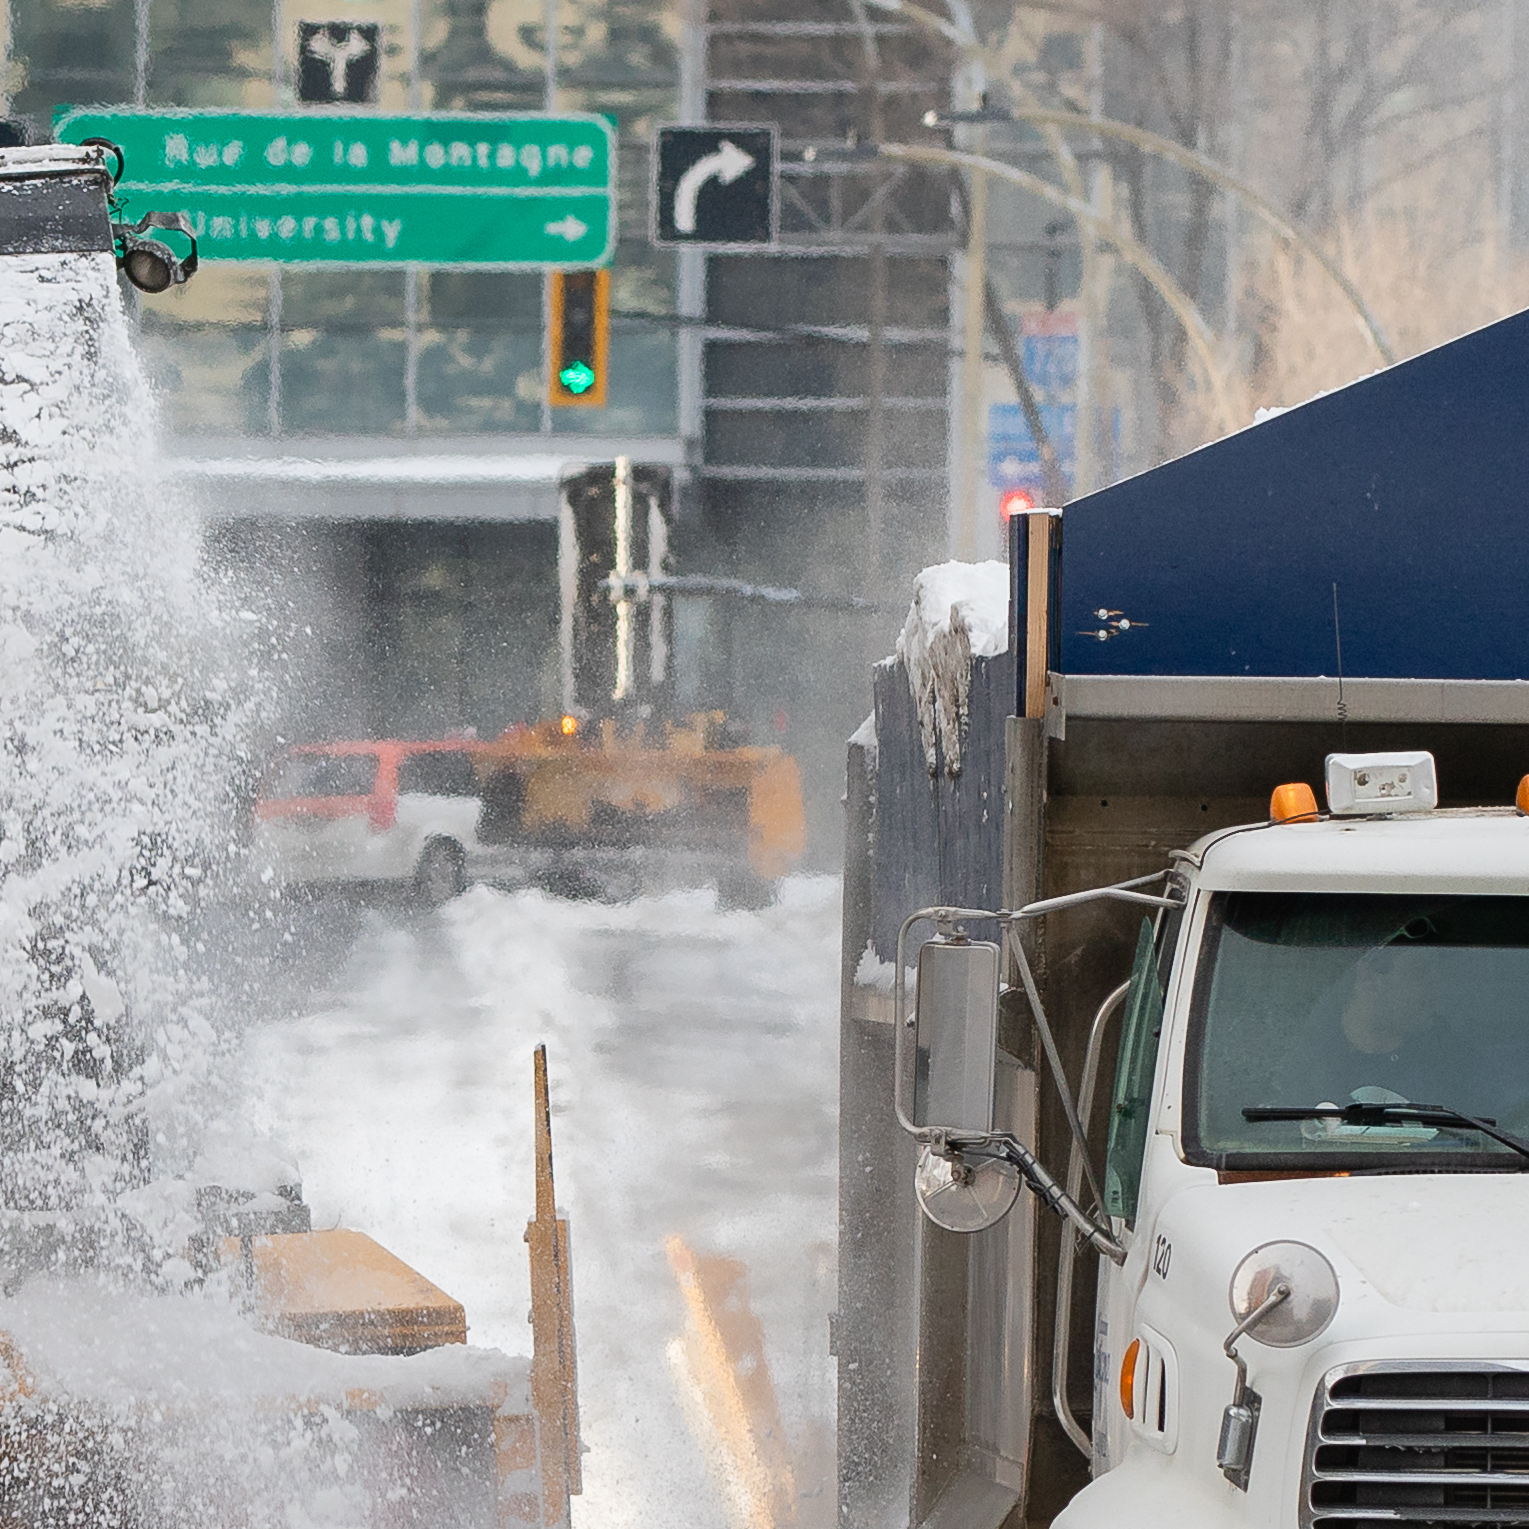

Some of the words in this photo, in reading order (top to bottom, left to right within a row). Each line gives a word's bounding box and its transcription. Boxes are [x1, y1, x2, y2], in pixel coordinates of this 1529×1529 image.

[163, 132, 243, 169] Rue
[264, 135, 314, 168] de
[333, 138, 369, 168] la
[387, 137, 594, 179] Montagne
[1153, 1233, 1172, 1280] 120
